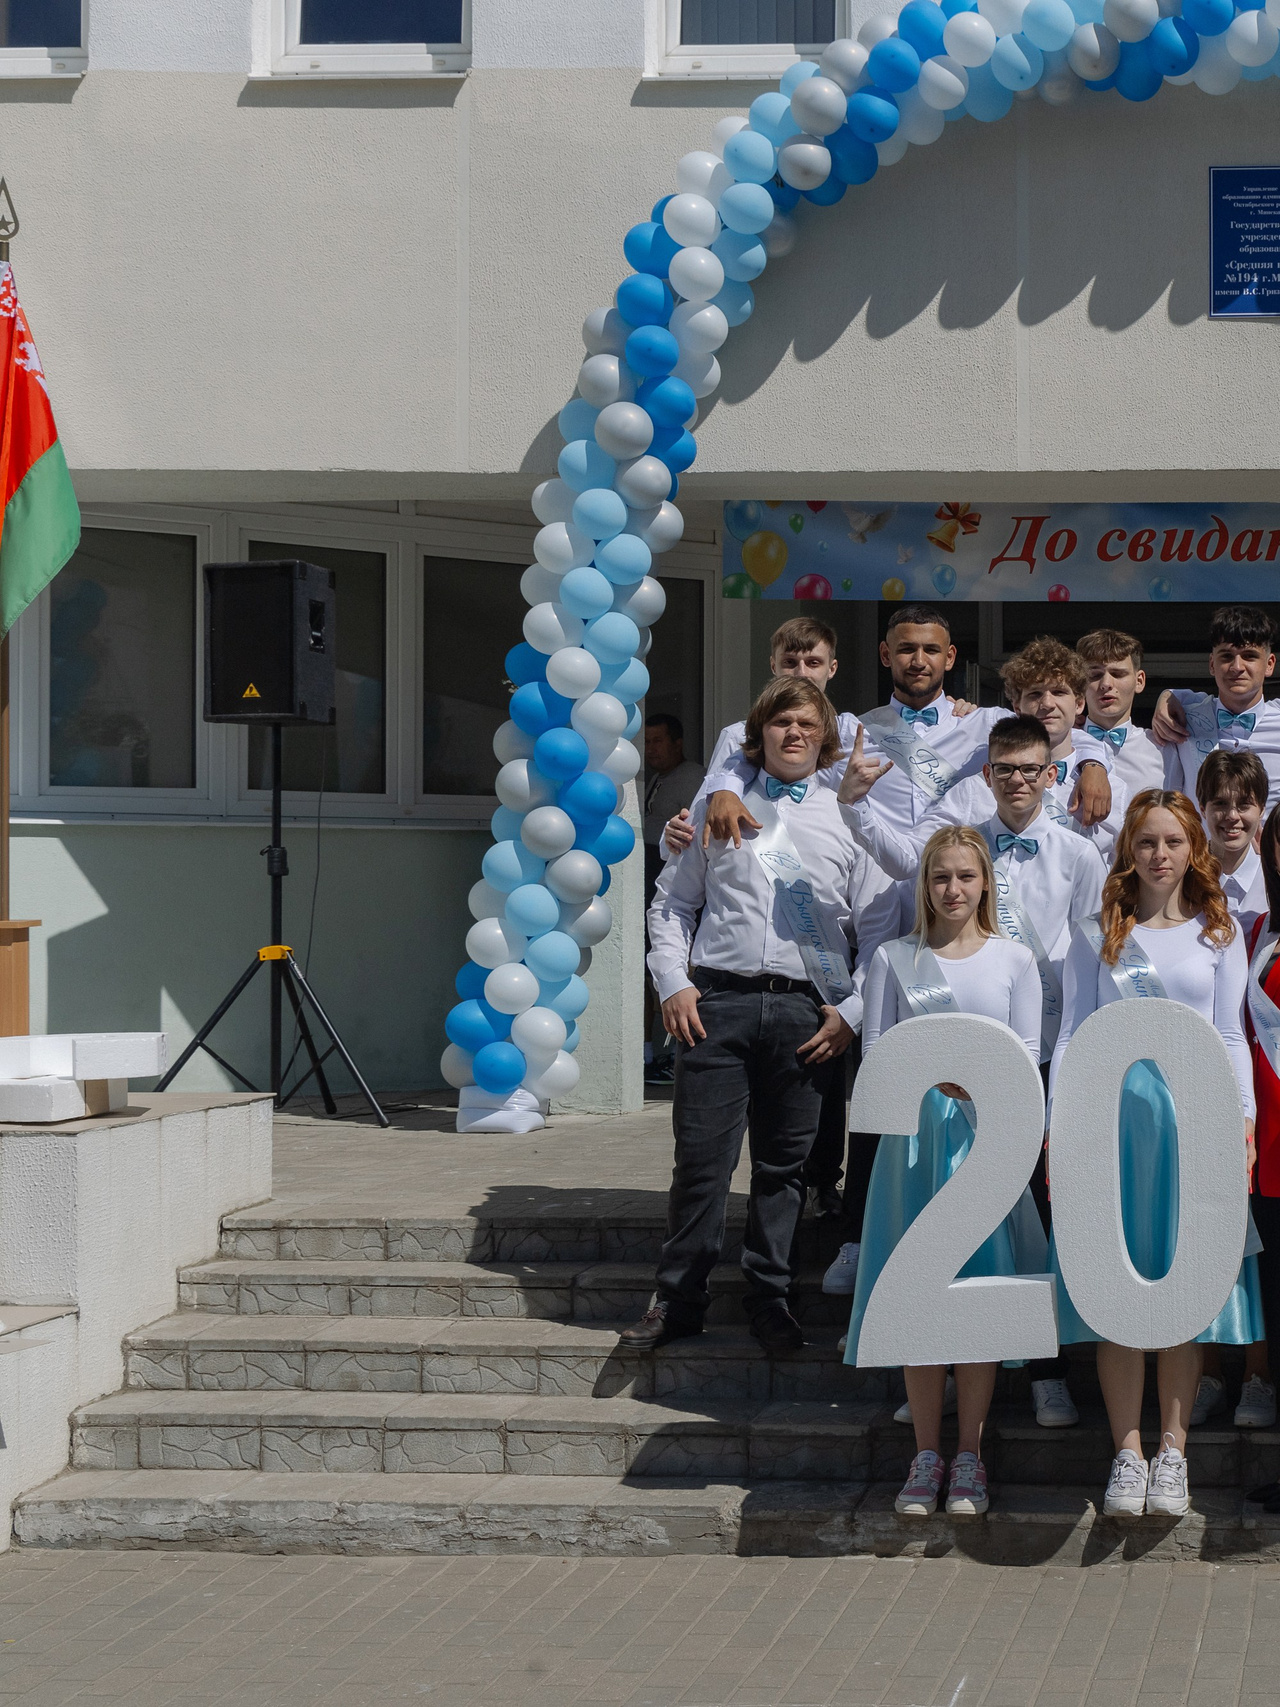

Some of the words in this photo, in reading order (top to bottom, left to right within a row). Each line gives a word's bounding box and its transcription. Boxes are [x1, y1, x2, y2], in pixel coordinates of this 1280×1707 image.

[1224, 273, 1259, 282] №194
[1225, 260, 1273, 271] «Средняя
[988, 515, 1078, 575] До
[785, 878, 834, 980] Выпускник
